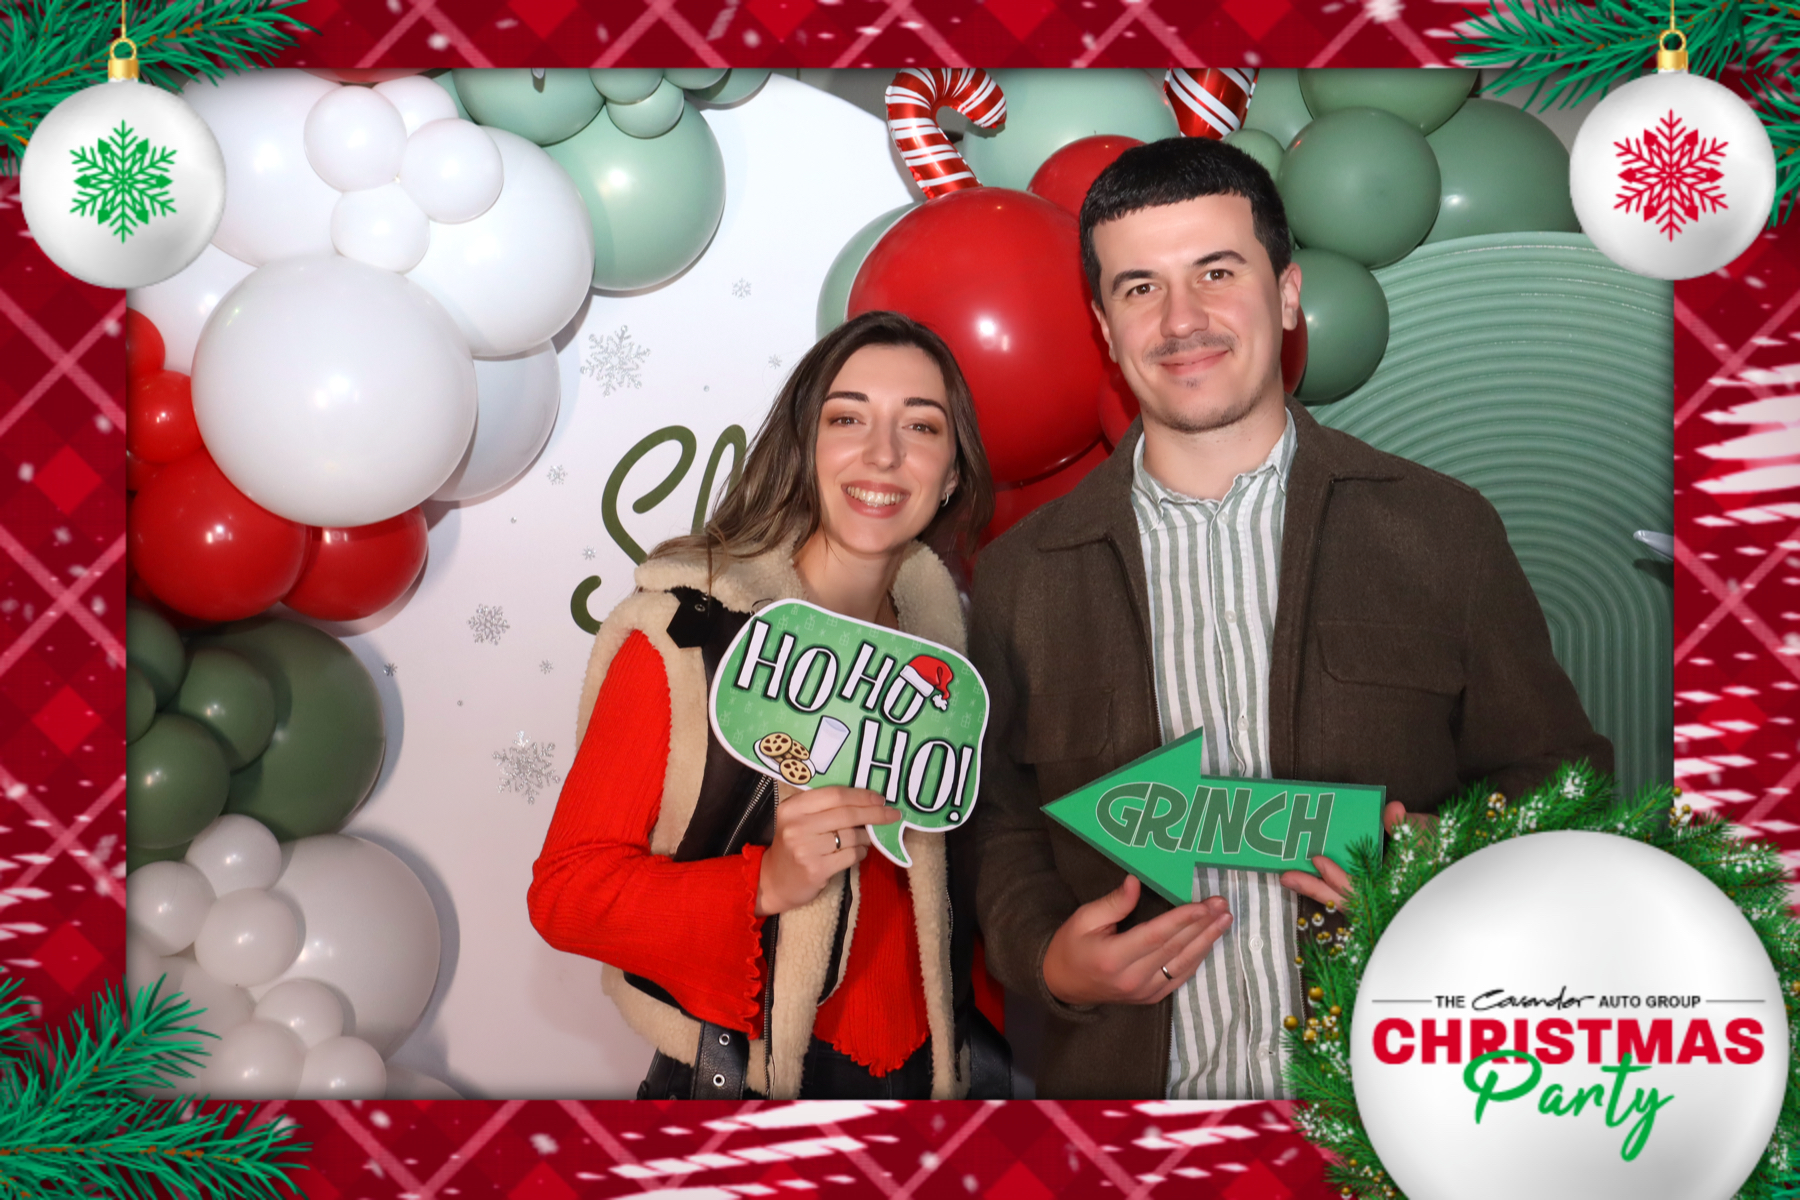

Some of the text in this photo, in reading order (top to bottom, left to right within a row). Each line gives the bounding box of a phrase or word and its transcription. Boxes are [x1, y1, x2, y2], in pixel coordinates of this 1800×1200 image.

[733, 618, 927, 726] HO HO
[852, 717, 974, 823] HO!
[1095, 781, 1335, 861] GRINCH
